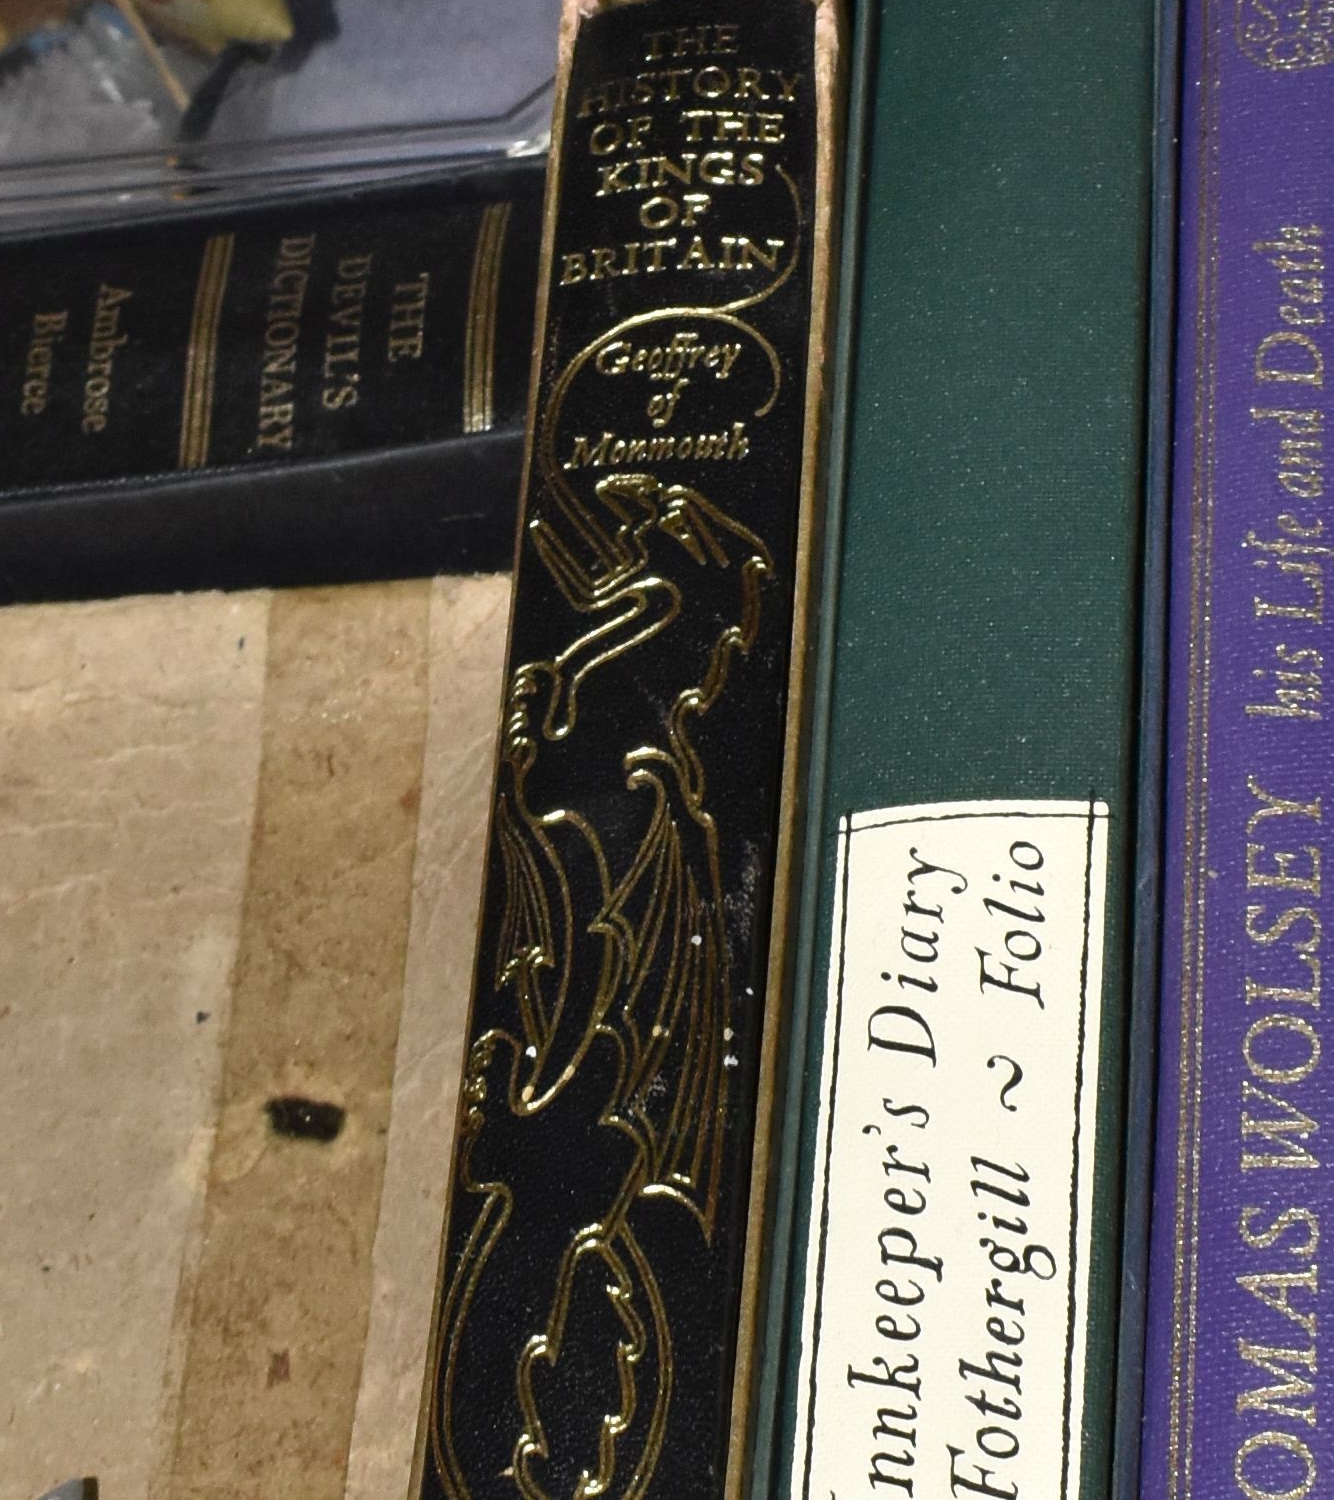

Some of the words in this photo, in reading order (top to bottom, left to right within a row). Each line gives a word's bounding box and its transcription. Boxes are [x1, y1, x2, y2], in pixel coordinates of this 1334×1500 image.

[642, 22, 741, 64] THE
[574, 66, 805, 118] HISTORY
[588, 115, 653, 156] OF
[680, 108, 788, 144] THE
[594, 151, 766, 198] KINGS
[638, 193, 713, 230] OF
[558, 235, 786, 287] BRITAIN
[256, 231, 319, 452] DICTIONARY
[320, 252, 374, 413] DEVIL'S
[387, 271, 431, 364] THE
[1253, 218, 1327, 390] Death
[18, 309, 69, 418] Bierce
[80, 282, 135, 436] Ambrose
[593, 331, 743, 380] Geoffrey
[646, 376, 690, 429] of
[561, 421, 751, 471] Monmouth
[1249, 408, 1325, 498] and
[1243, 642, 1324, 722] his
[867, 845, 973, 1069] Diary
[978, 837, 1048, 1011] Folio
[1240, 773, 1325, 1174] WOLSEY
